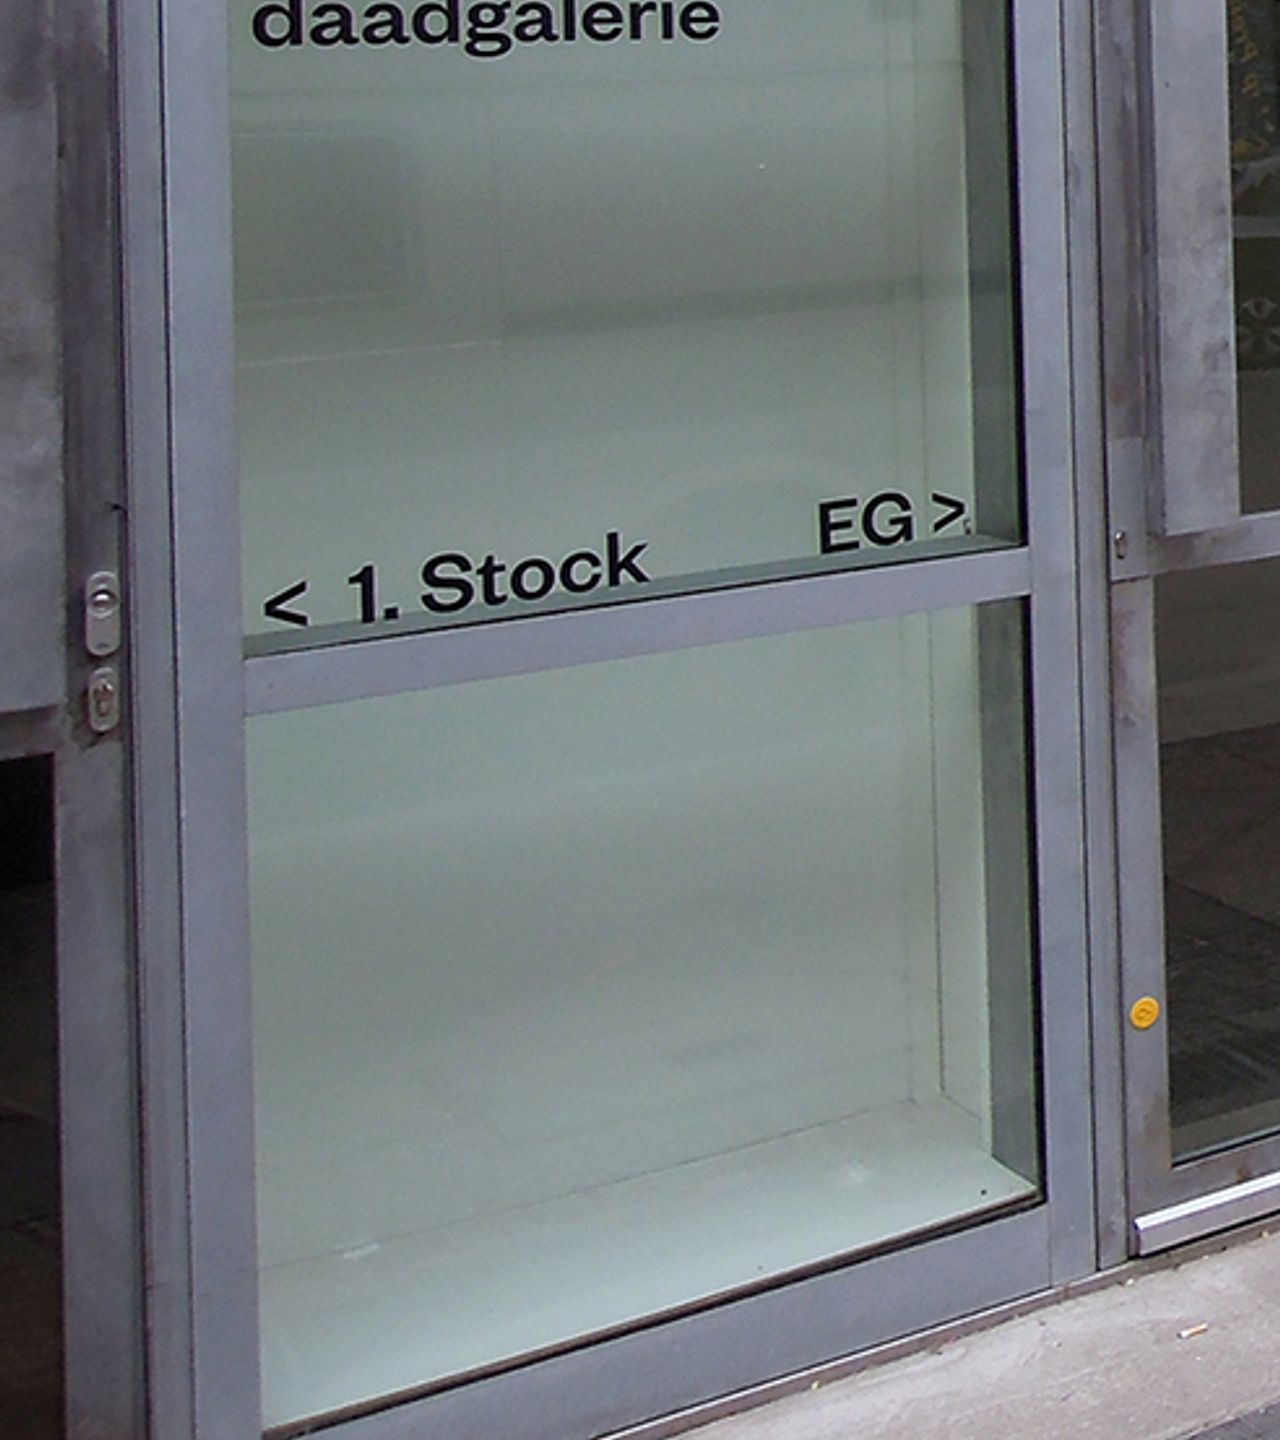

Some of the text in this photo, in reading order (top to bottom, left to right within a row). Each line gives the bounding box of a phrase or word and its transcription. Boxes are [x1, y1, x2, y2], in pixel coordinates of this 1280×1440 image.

[819, 492, 914, 556] EG
[347, 564, 399, 625] 1.
[420, 531, 650, 615] Stock
